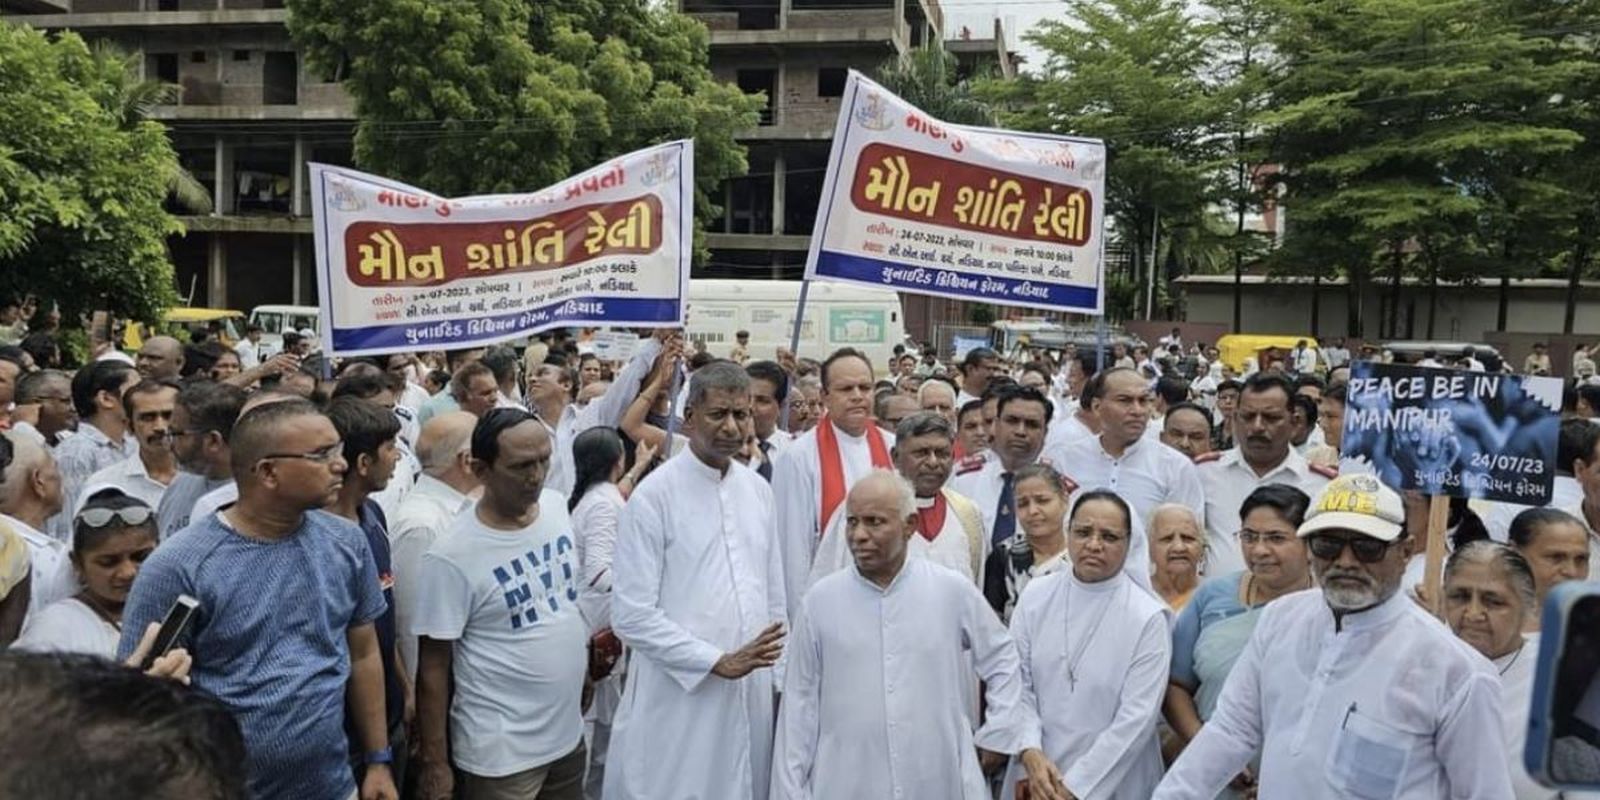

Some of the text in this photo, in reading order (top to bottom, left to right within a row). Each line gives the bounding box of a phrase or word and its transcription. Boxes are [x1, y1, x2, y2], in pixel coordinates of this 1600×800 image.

[864, 155, 1086, 242] મૌન શાંતિ રેલી
[358, 198, 654, 281] મૌન શાંતિ રેલી
[1348, 376, 1500, 401] PEACE BE IN
[1348, 406, 1454, 434] MANIPUR
[1471, 453, 1545, 474] 24/07/23
